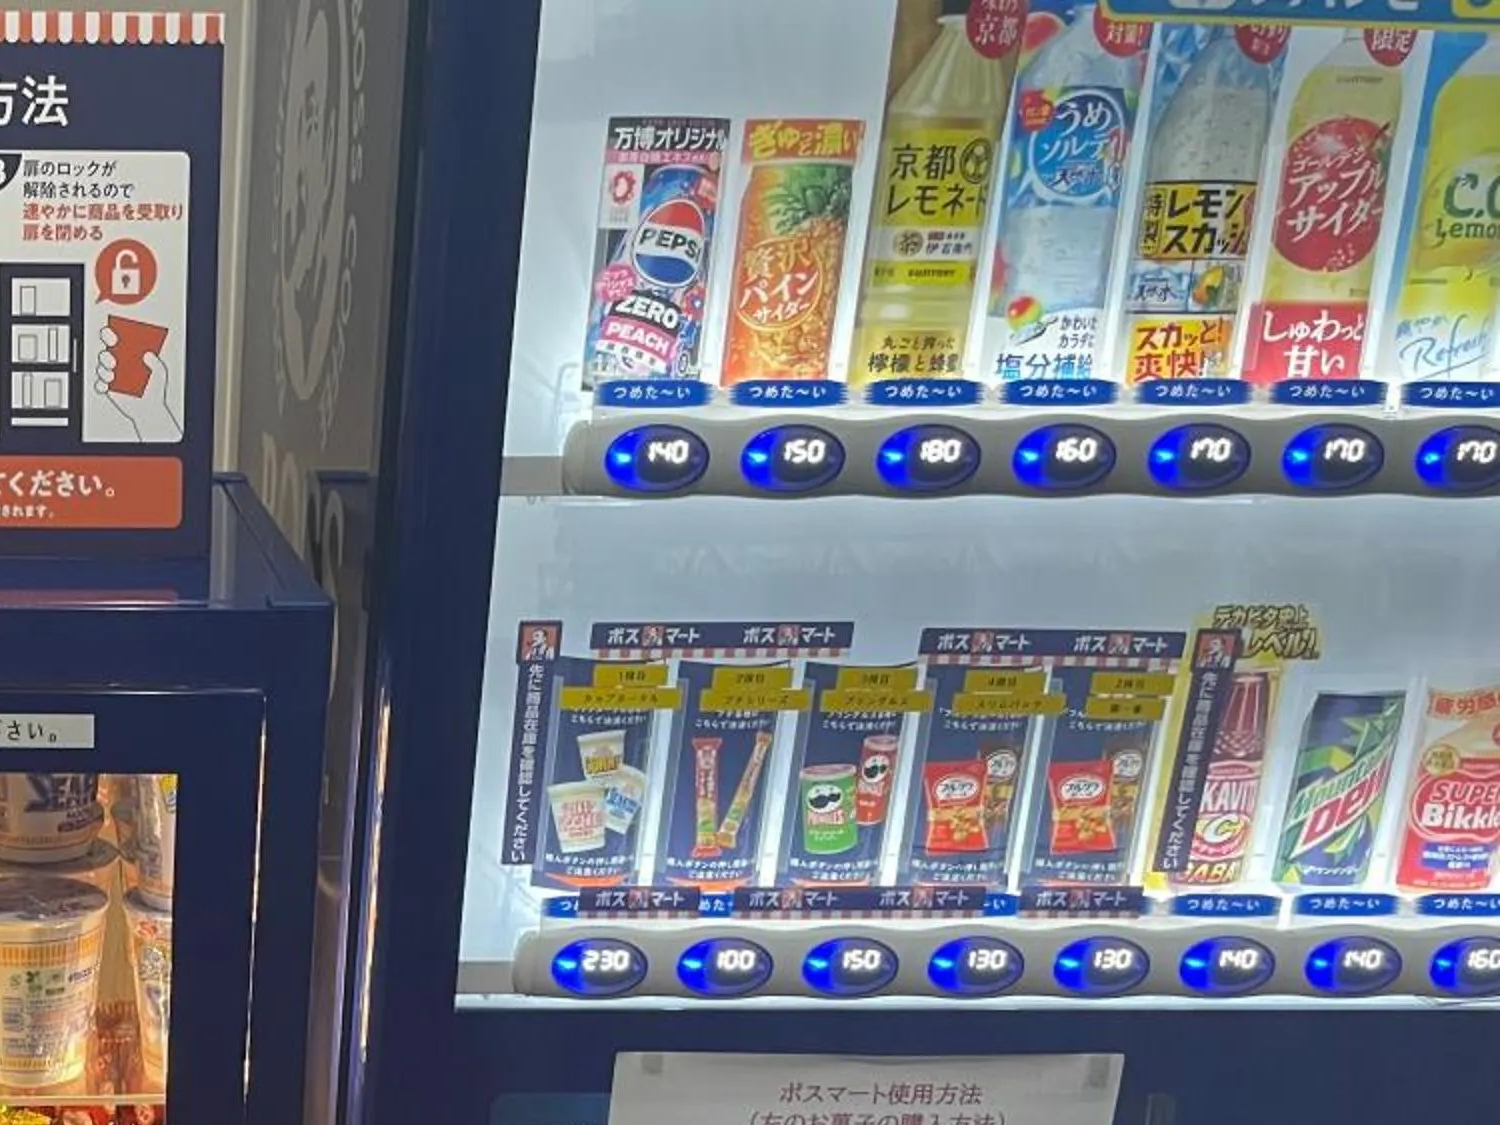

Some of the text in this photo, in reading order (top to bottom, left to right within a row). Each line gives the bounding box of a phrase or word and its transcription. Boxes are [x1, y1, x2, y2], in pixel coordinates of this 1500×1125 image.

[1055, 102, 1113, 138] うめ
[23, 159, 117, 177] 扉のロックが
[890, 143, 956, 181] 京都
[23, 181, 136, 199] 解除されるので
[1289, 162, 1386, 209] アップル
[23, 203, 184, 221] 速やかに商品を受取り
[1167, 189, 1244, 220] レモン
[23, 224, 104, 242] 扉を閉める
[1286, 201, 1385, 243] サイダー
[639, 227, 701, 260] PEPS
[740, 270, 819, 309] パイン
[615, 294, 679, 330] ZERO
[752, 299, 811, 325] サイダー
[1263, 310, 1365, 343] しゅわっと
[606, 321, 671, 359] PEACH
[1284, 345, 1345, 379] 甘い
[647, 439, 689, 464] 140
[783, 439, 825, 464] 150
[920, 438, 962, 463] 180
[1055, 437, 1097, 462] 160
[1190, 437, 1231, 462] 170
[1325, 437, 1366, 462] 170
[1457, 440, 1498, 464] 170
[607, 627, 701, 645] ボス マート
[743, 625, 837, 644] ボス マート
[937, 634, 1032, 652] ボス マート
[1073, 635, 1168, 653] ボス マート
[582, 950, 631, 970] 230
[716, 950, 756, 969] 100
[843, 950, 881, 969] 150
[968, 949, 1007, 969] 130
[1094, 949, 1132, 969] 130
[1219, 949, 1258, 969] 140
[1344, 949, 1383, 969] 140
[779, 1082, 984, 1105] ボスマート使用方法
